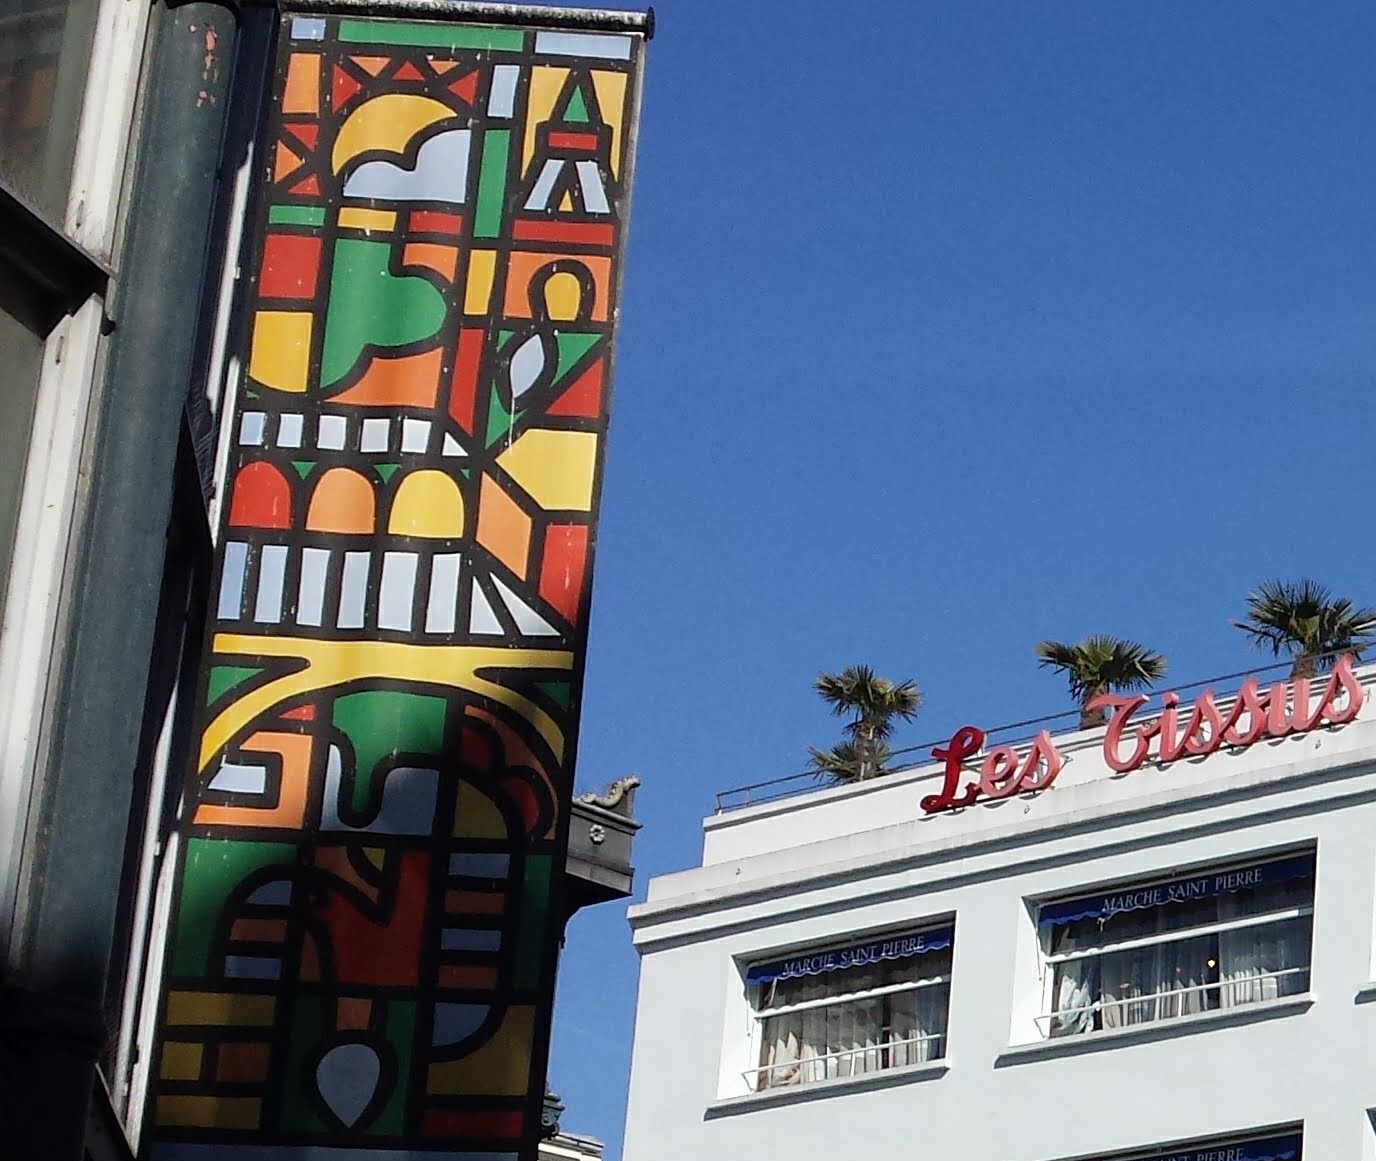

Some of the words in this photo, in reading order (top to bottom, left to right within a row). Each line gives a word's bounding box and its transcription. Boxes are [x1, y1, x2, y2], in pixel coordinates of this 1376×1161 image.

[919, 725, 1063, 814] Les
[1086, 652, 1364, 773] Tissus
[1102, 888, 1162, 911] MARCHE
[1168, 877, 1209, 898] SAINT
[1214, 866, 1264, 890] PIERRE
[784, 954, 835, 975] MARCHE
[840, 946, 879, 963] SAINT
[882, 935, 926, 956] PIERRE
